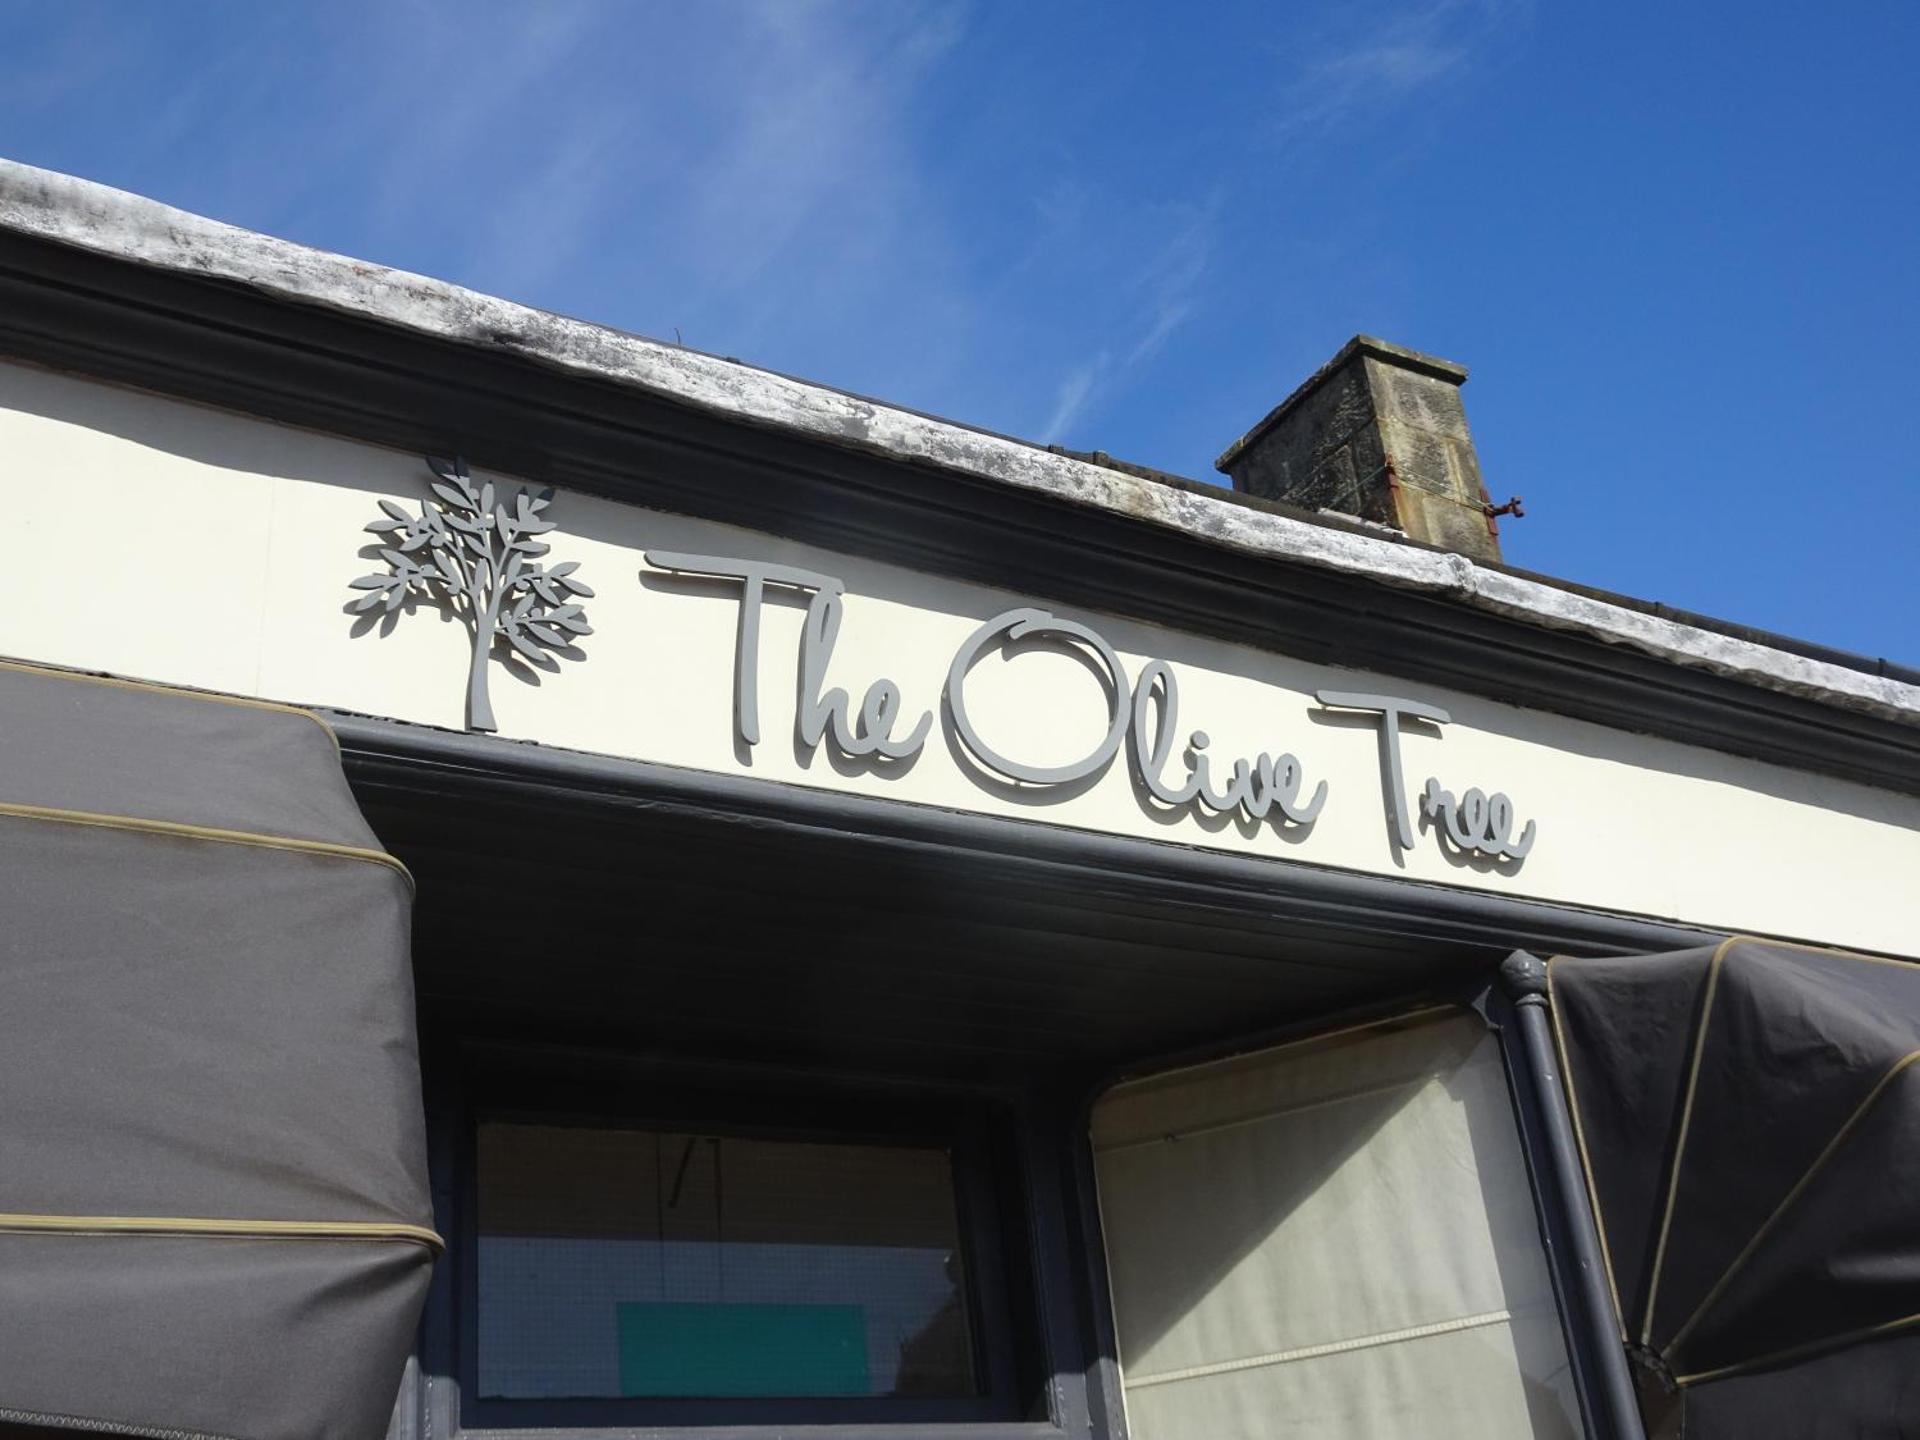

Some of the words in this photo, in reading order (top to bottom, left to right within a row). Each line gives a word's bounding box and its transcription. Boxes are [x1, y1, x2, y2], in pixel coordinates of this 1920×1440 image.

[644, 549, 934, 758] The
[947, 607, 1329, 824] Olive
[1314, 689, 1537, 860] Tree
